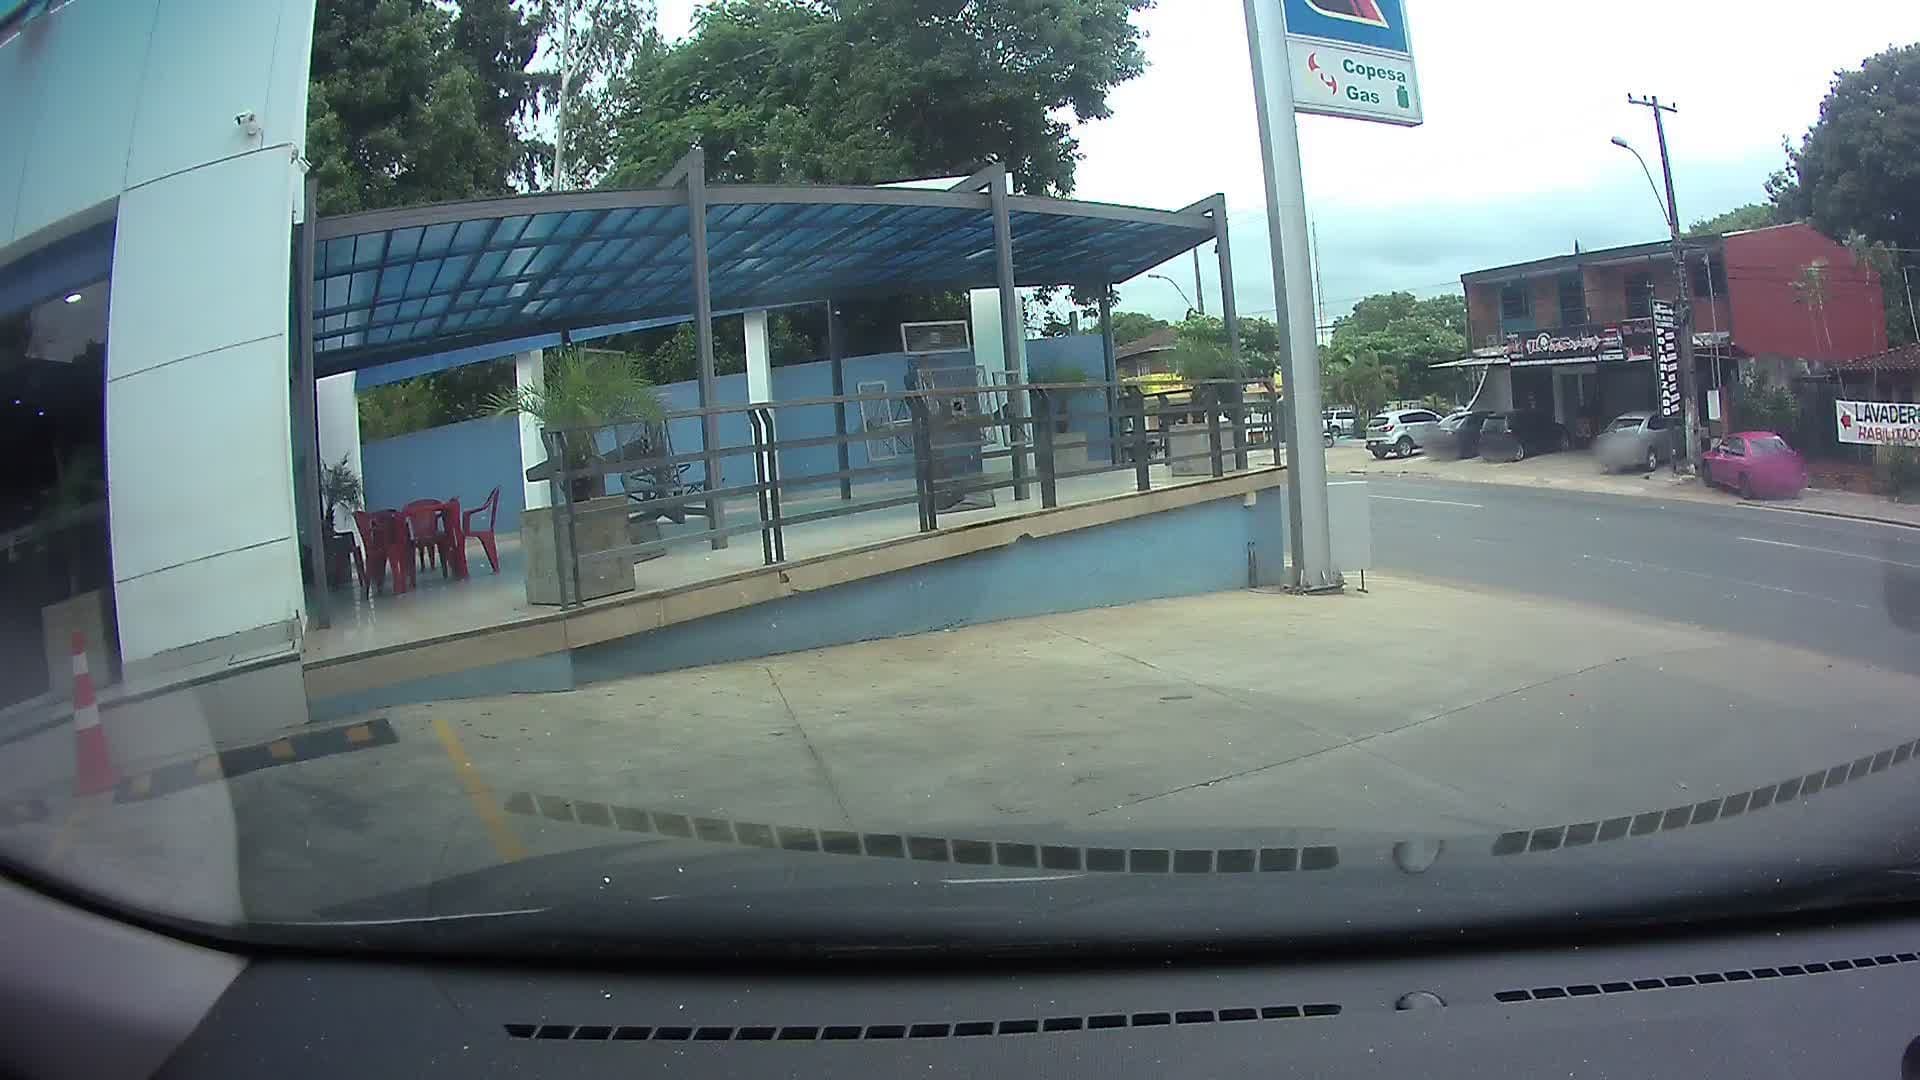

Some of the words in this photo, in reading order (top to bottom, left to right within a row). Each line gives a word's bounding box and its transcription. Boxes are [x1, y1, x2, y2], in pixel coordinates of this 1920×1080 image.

[1342, 59, 1406, 83] Copesa
[1346, 85, 1380, 104] Gas
[1656, 328, 1671, 416] POLARIZADO
